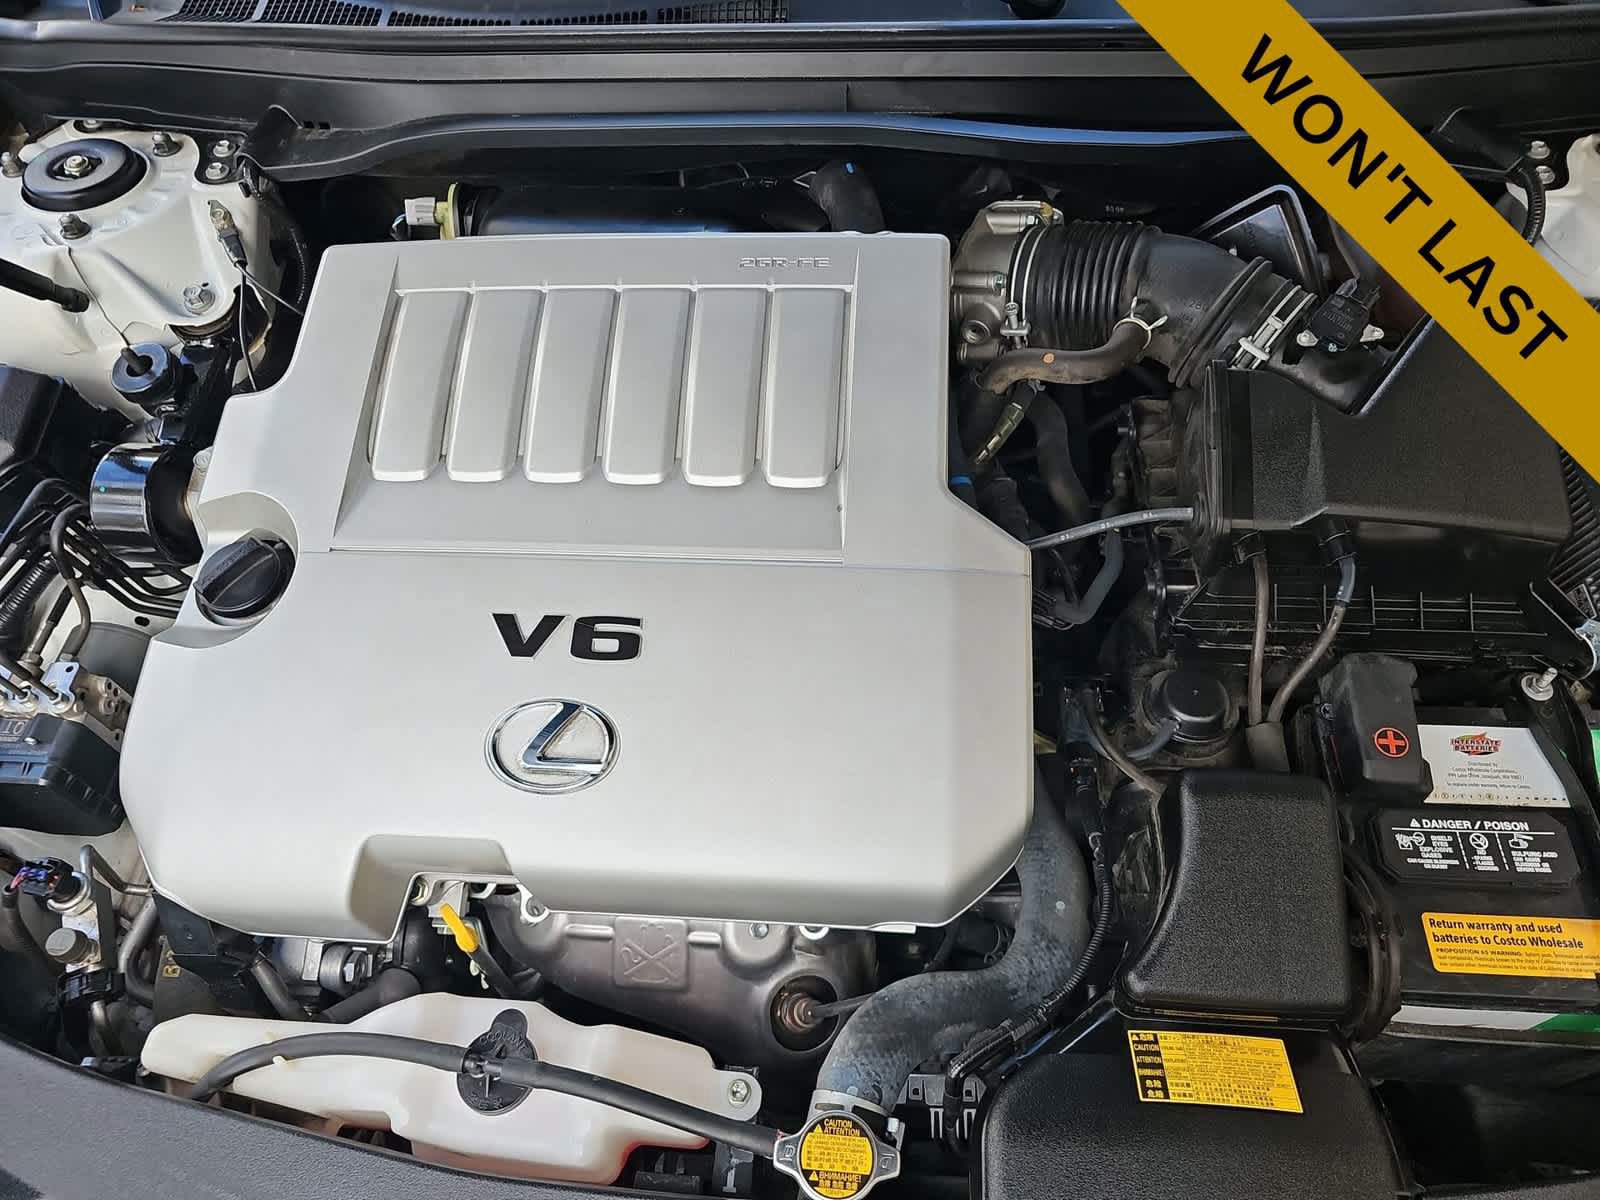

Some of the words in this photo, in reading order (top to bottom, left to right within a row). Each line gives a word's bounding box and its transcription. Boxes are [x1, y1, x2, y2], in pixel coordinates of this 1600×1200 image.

[492, 612, 643, 662] V6
[1450, 738, 1502, 746] INTERSTATE
[1422, 819, 1472, 830] DANGER
[1484, 821, 1530, 831] POISON
[1428, 918, 1464, 929] Return
[1464, 920, 1513, 934] warranty
[1515, 922, 1536, 933] and
[1537, 923, 1563, 934] used
[1432, 932, 1479, 945] batteries
[1480, 934, 1492, 945] to
[1493, 935, 1527, 947] Costco
[1528, 936, 1584, 949] Wholesale
[1133, 1043, 1159, 1051] CAUTION
[823, 1118, 853, 1128] CAUTION
[823, 1127, 861, 1137] ATTENTION
